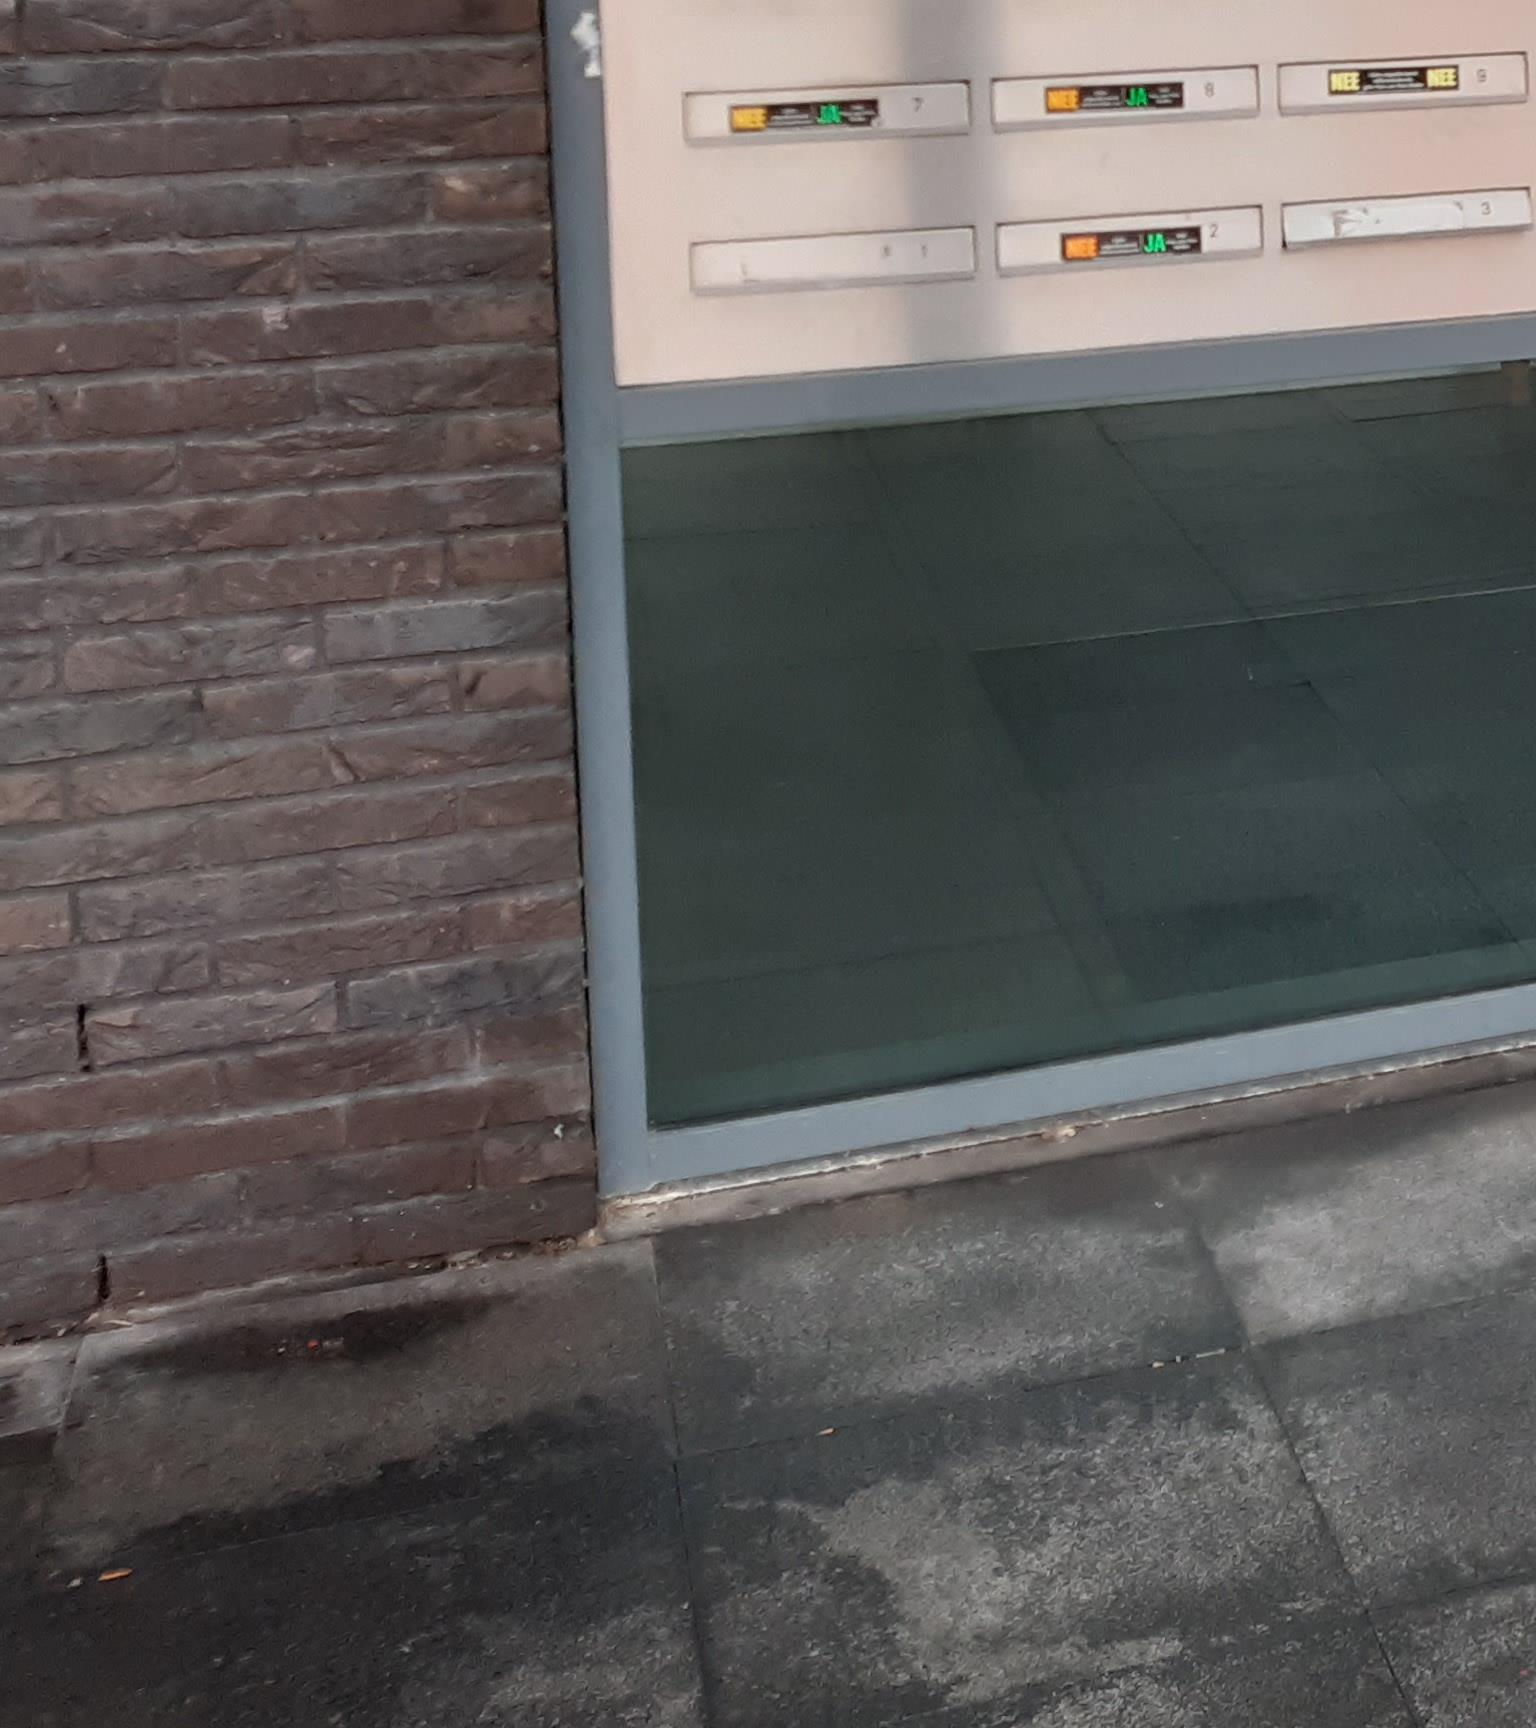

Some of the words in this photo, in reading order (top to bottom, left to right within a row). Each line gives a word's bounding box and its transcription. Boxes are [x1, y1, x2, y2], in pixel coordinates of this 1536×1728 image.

[1126, 87, 1148, 106] JA
[1480, 201, 1492, 216] 3
[1208, 223, 1219, 238] 2
[1143, 233, 1167, 253] JA
